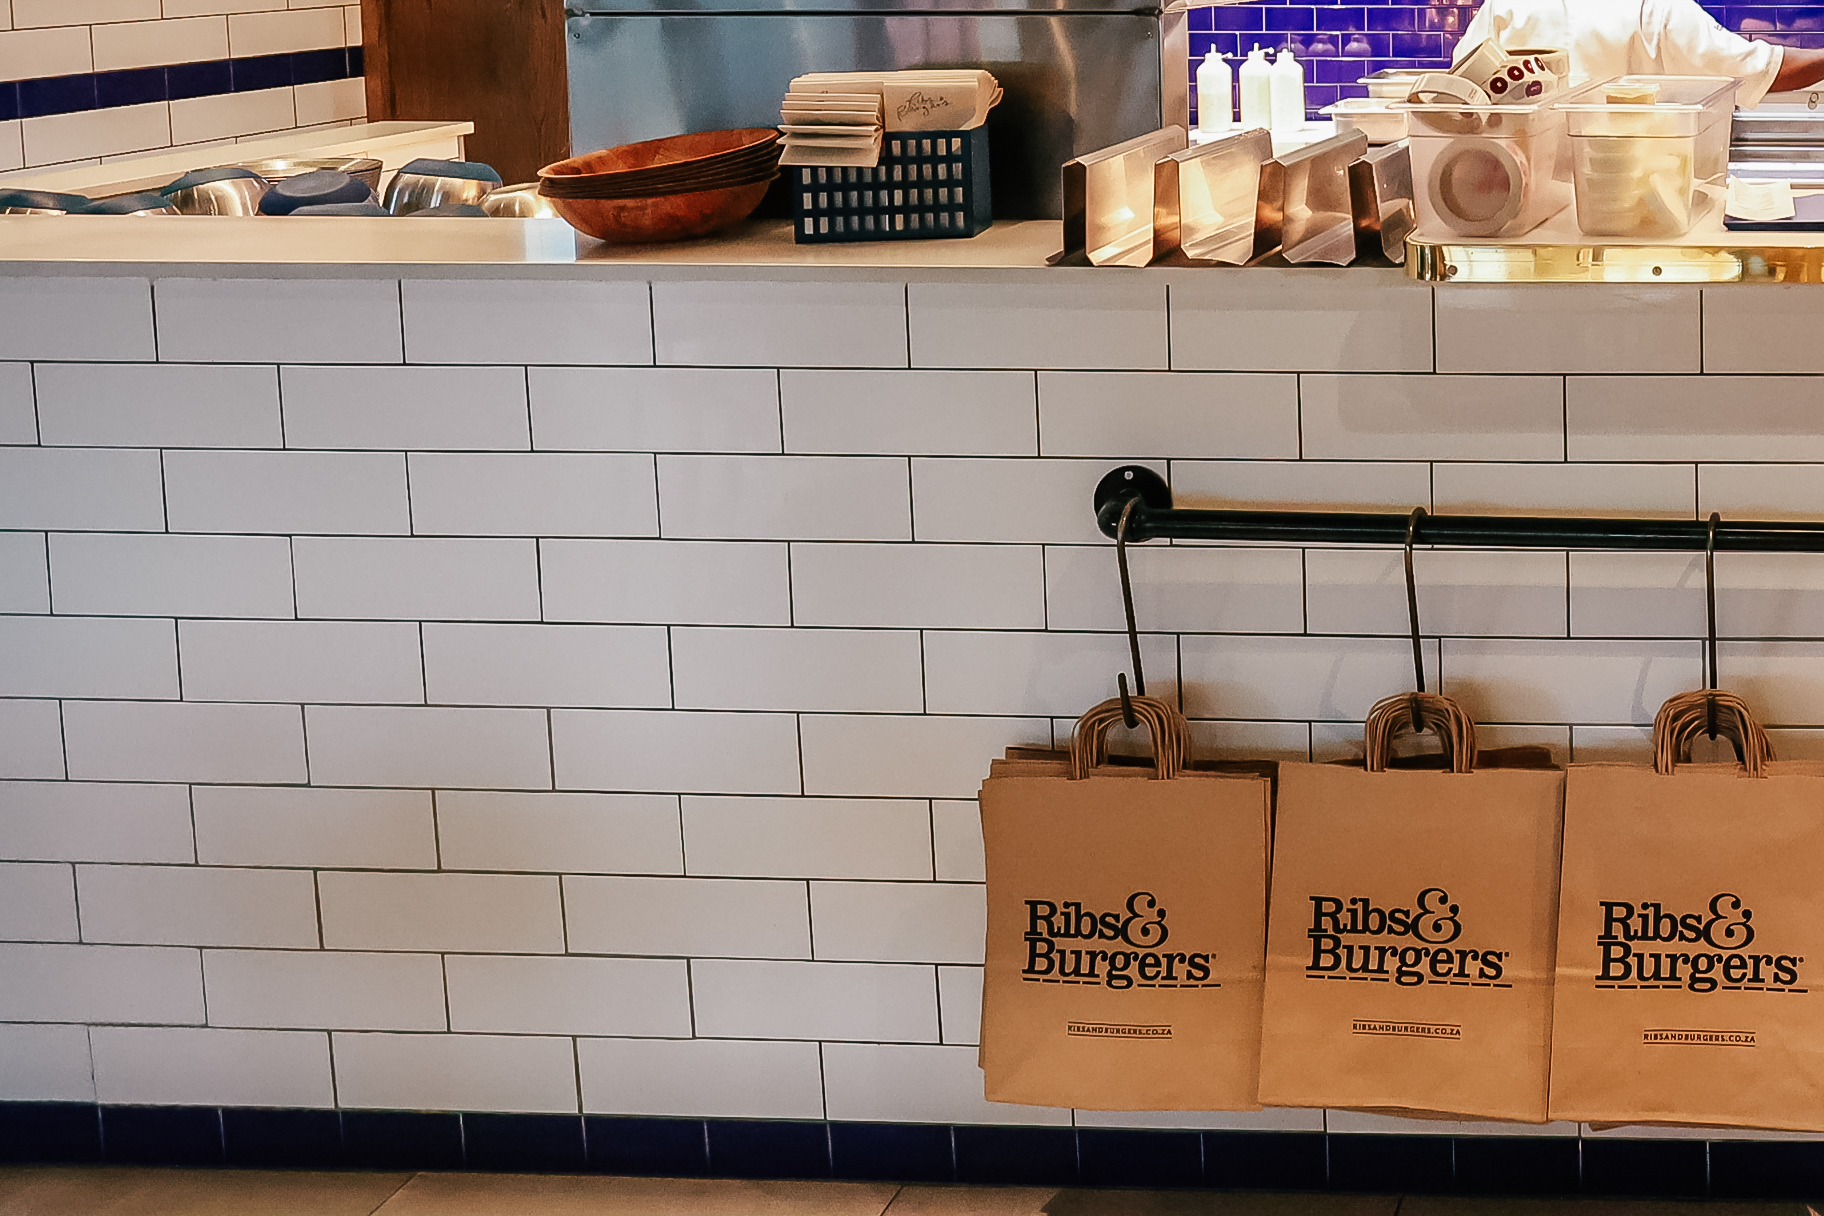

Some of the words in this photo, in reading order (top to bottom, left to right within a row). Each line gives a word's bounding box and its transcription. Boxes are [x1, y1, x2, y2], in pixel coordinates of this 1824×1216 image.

[1022, 936, 1218, 989] Burgers
[1305, 933, 1510, 987] Burgers
[1594, 940, 1804, 992] Burgers
